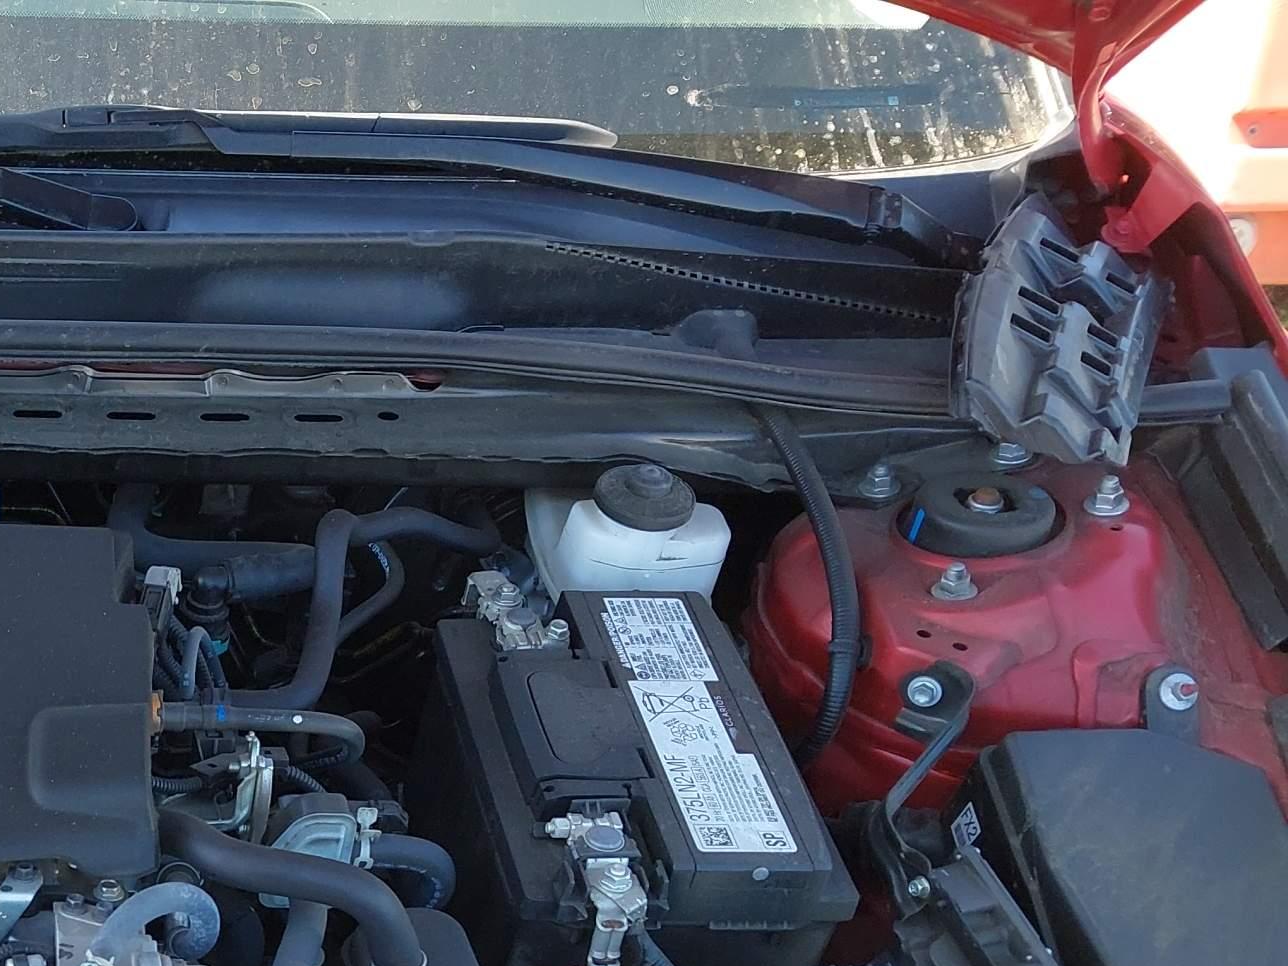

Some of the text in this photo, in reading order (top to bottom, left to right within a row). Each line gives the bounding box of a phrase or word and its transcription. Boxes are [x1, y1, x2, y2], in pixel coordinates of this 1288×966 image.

[699, 697, 713, 710] Pb
[714, 695, 734, 727] CLARIOS
[664, 753, 710, 822] 375LN2-MF
[762, 832, 787, 847] SP
[961, 807, 977, 841] FX2
